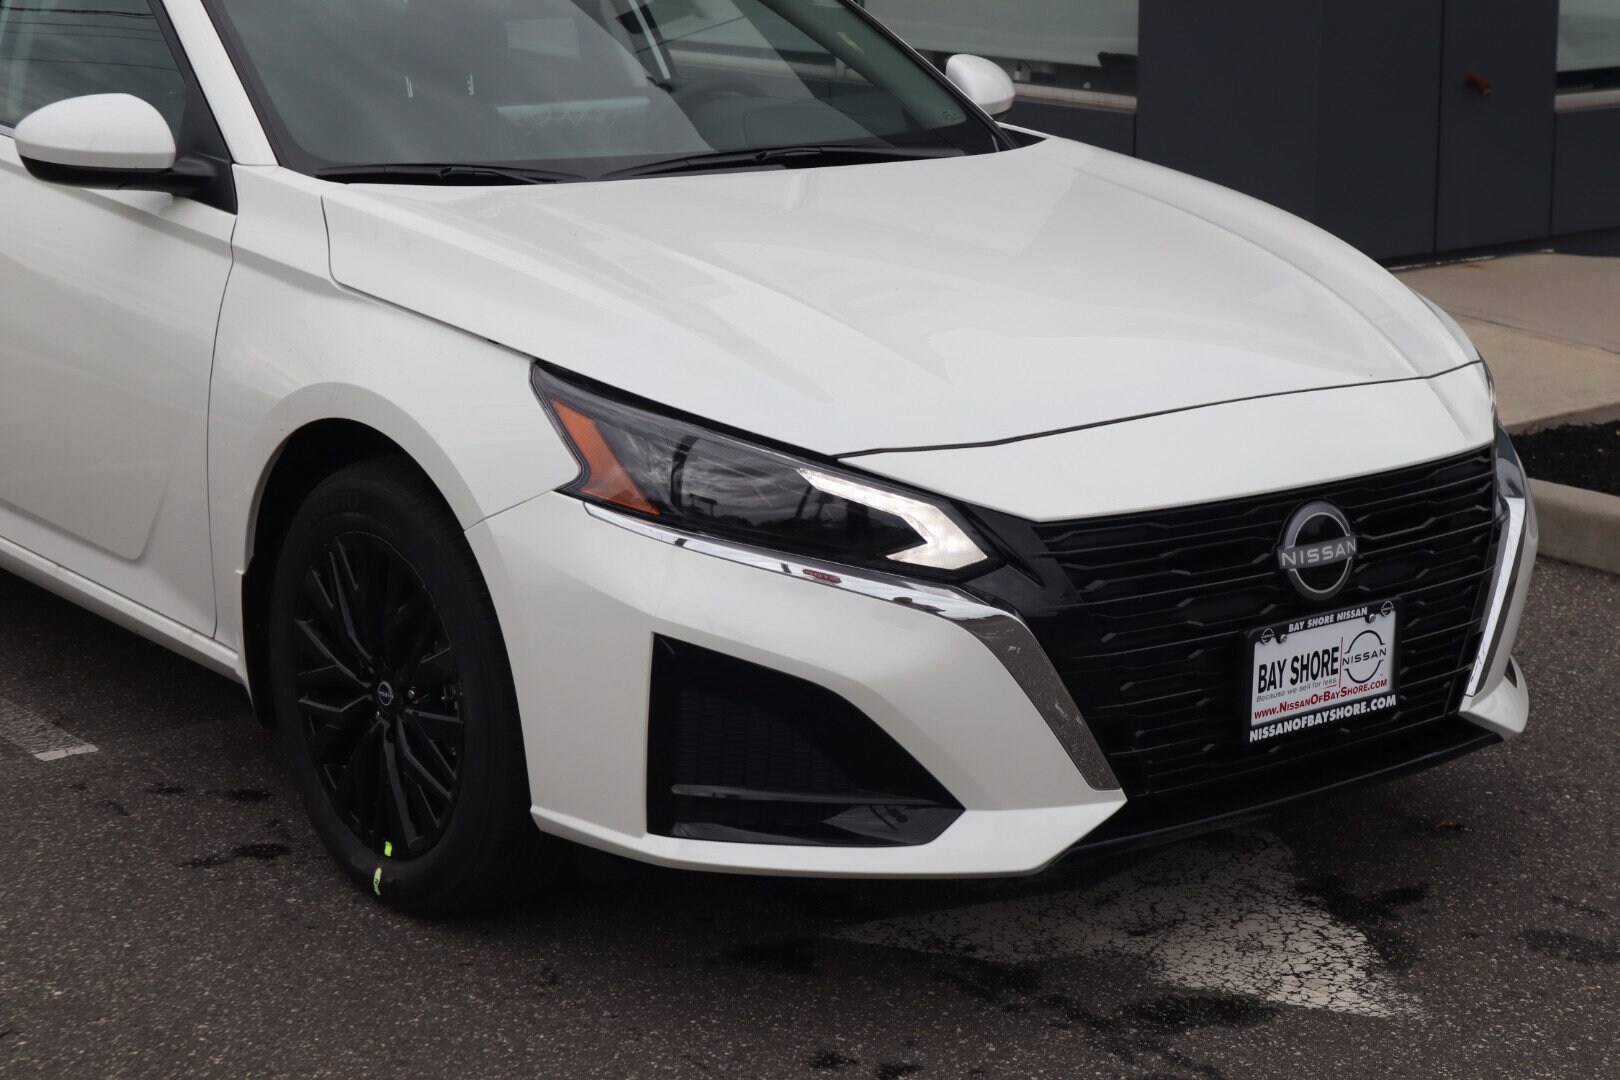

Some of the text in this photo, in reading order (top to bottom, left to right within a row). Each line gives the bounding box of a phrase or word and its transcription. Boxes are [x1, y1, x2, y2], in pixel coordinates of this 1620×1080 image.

[303, 493, 360, 529] UMHO
[1281, 538, 1357, 566] NISSAN
[1288, 621, 1305, 633] BAY
[1307, 613, 1335, 629] SHORE
[1336, 606, 1368, 622] NISSAN
[1257, 646, 1340, 694] BAY SHORE
[1342, 647, 1387, 667] NISSAN
[1256, 690, 1286, 703] Because
[1287, 687, 1298, 695] we
[1299, 683, 1311, 692] sell
[1249, 694, 1397, 743] NISSANOFBAYSHORE.COM
